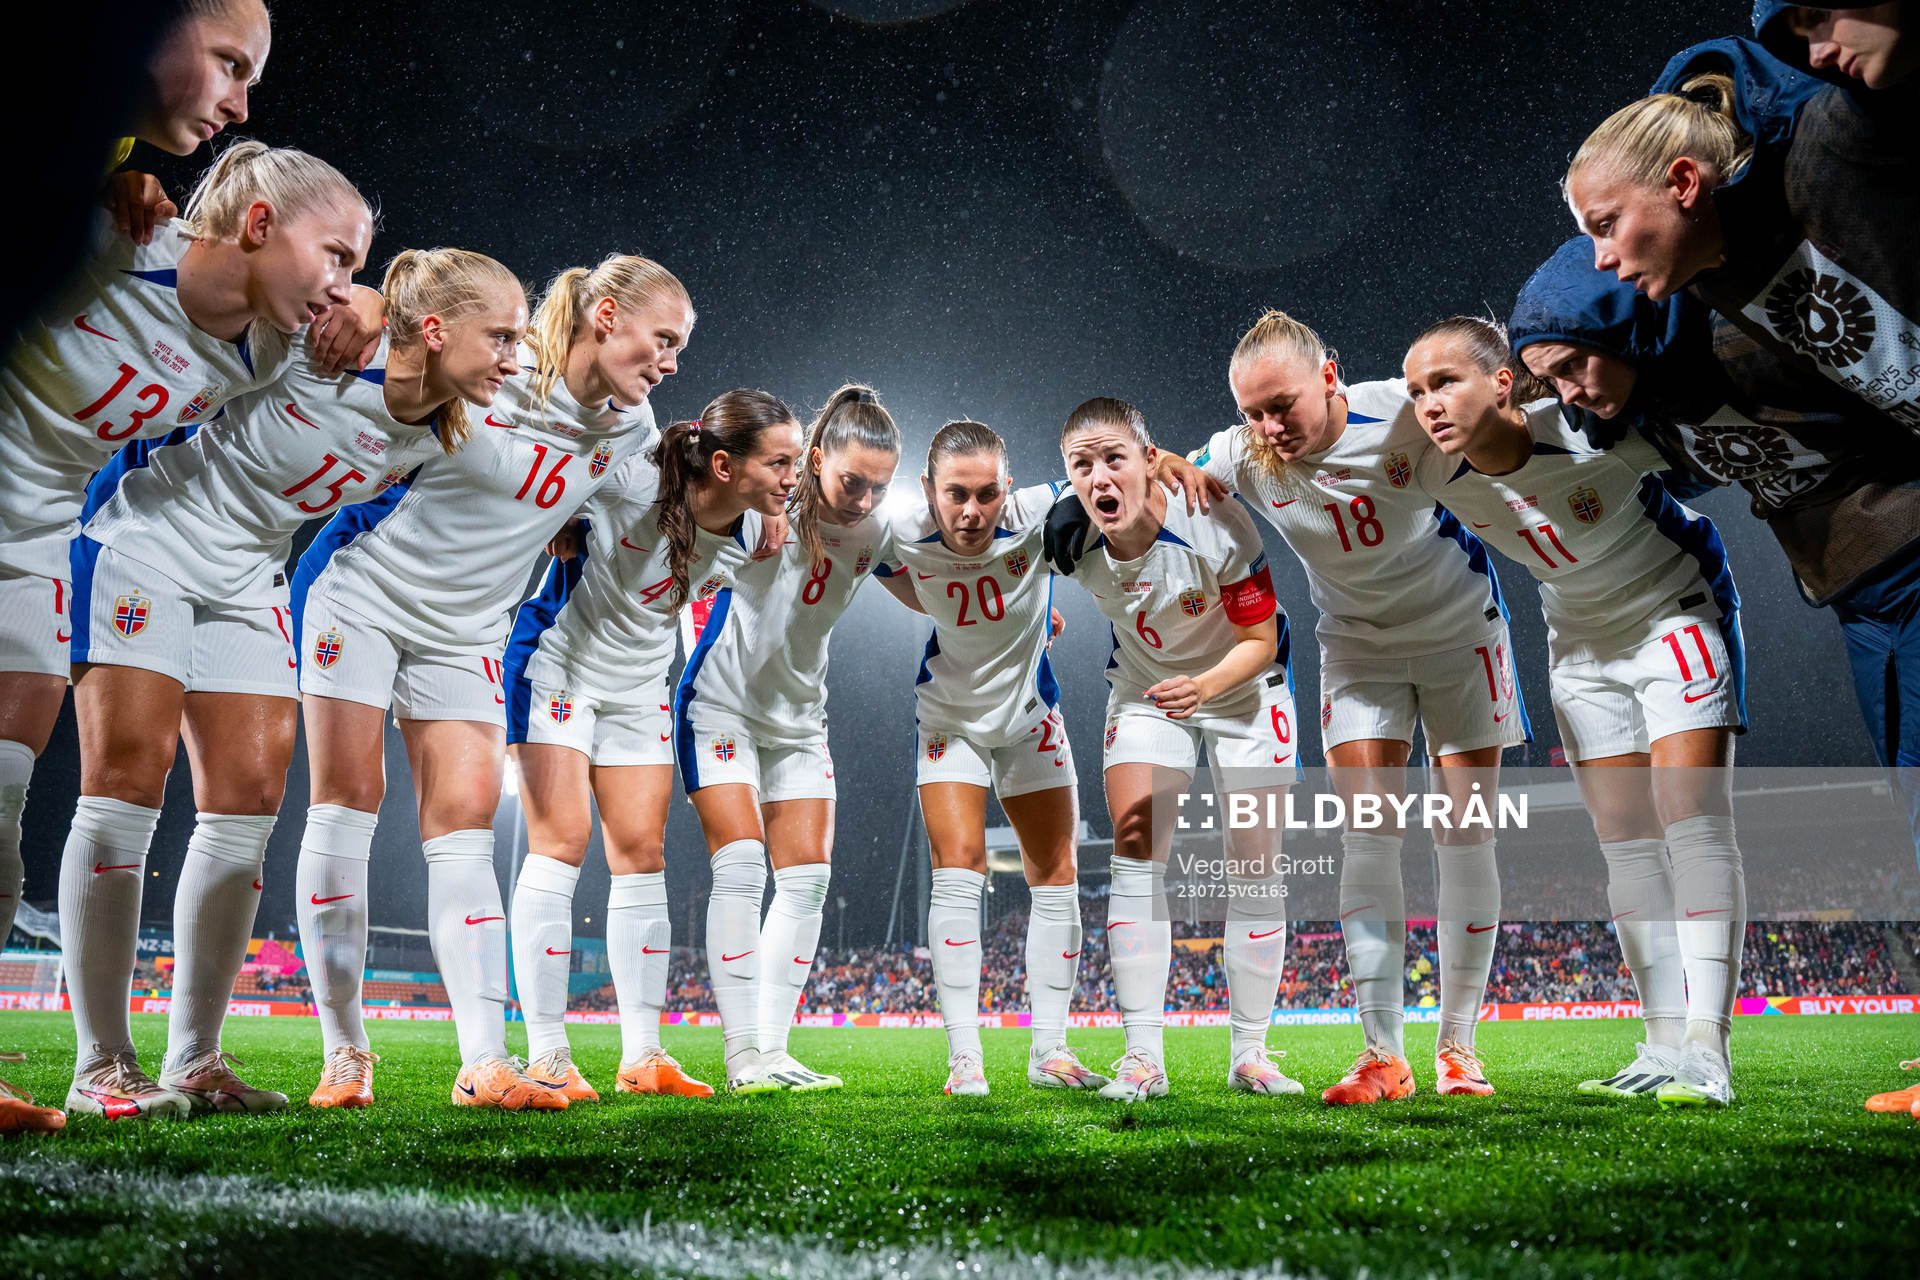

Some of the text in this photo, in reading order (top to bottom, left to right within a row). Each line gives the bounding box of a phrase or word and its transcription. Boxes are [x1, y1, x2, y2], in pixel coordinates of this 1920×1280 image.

[72, 362, 170, 441] 13
[281, 452, 368, 514] 15
[514, 443, 574, 510] 16
[1323, 495, 1385, 553] 18
[1516, 524, 1580, 569] 11
[639, 575, 674, 605] 4
[802, 556, 833, 606] 8
[946, 575, 1005, 627] 20
[1136, 610, 1163, 649] 6
[1661, 623, 1718, 682] 11
[1271, 704, 1291, 744] 6
[1275, 1013, 1352, 1025] AOTEAROA
[1800, 1000, 1847, 1015] BUY
[1850, 999, 1914, 1015] YOUR
